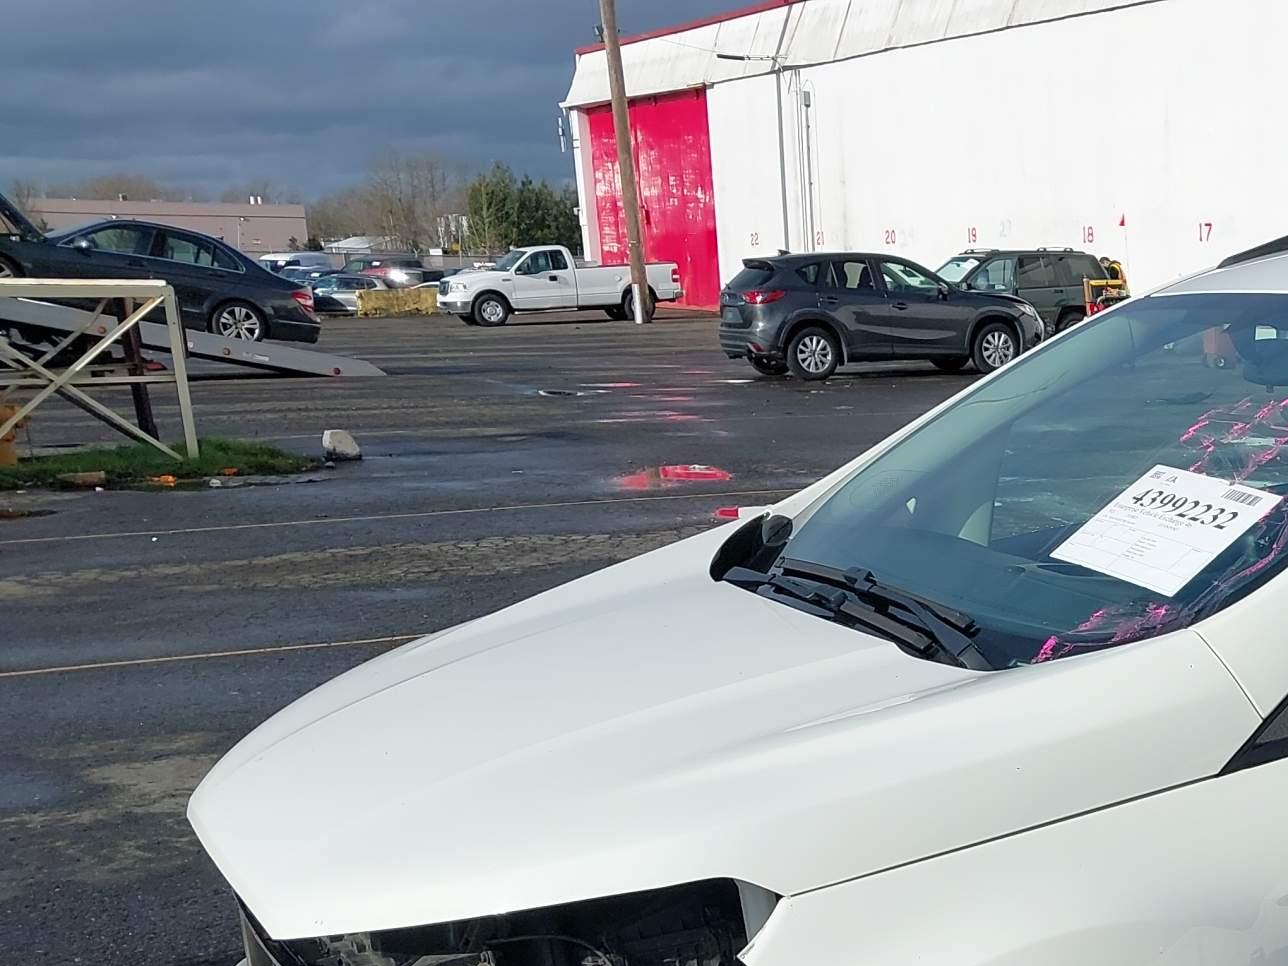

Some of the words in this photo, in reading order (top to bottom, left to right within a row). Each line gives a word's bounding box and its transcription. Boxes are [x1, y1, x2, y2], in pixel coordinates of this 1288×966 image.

[750, 233, 760, 246] 22
[816, 231, 825, 246] 21
[884, 229, 896, 245] 20
[967, 227, 977, 244] 19
[1082, 226, 1095, 243] 18
[1198, 223, 1213, 242] 17
[1131, 488, 1240, 530] 43992232
